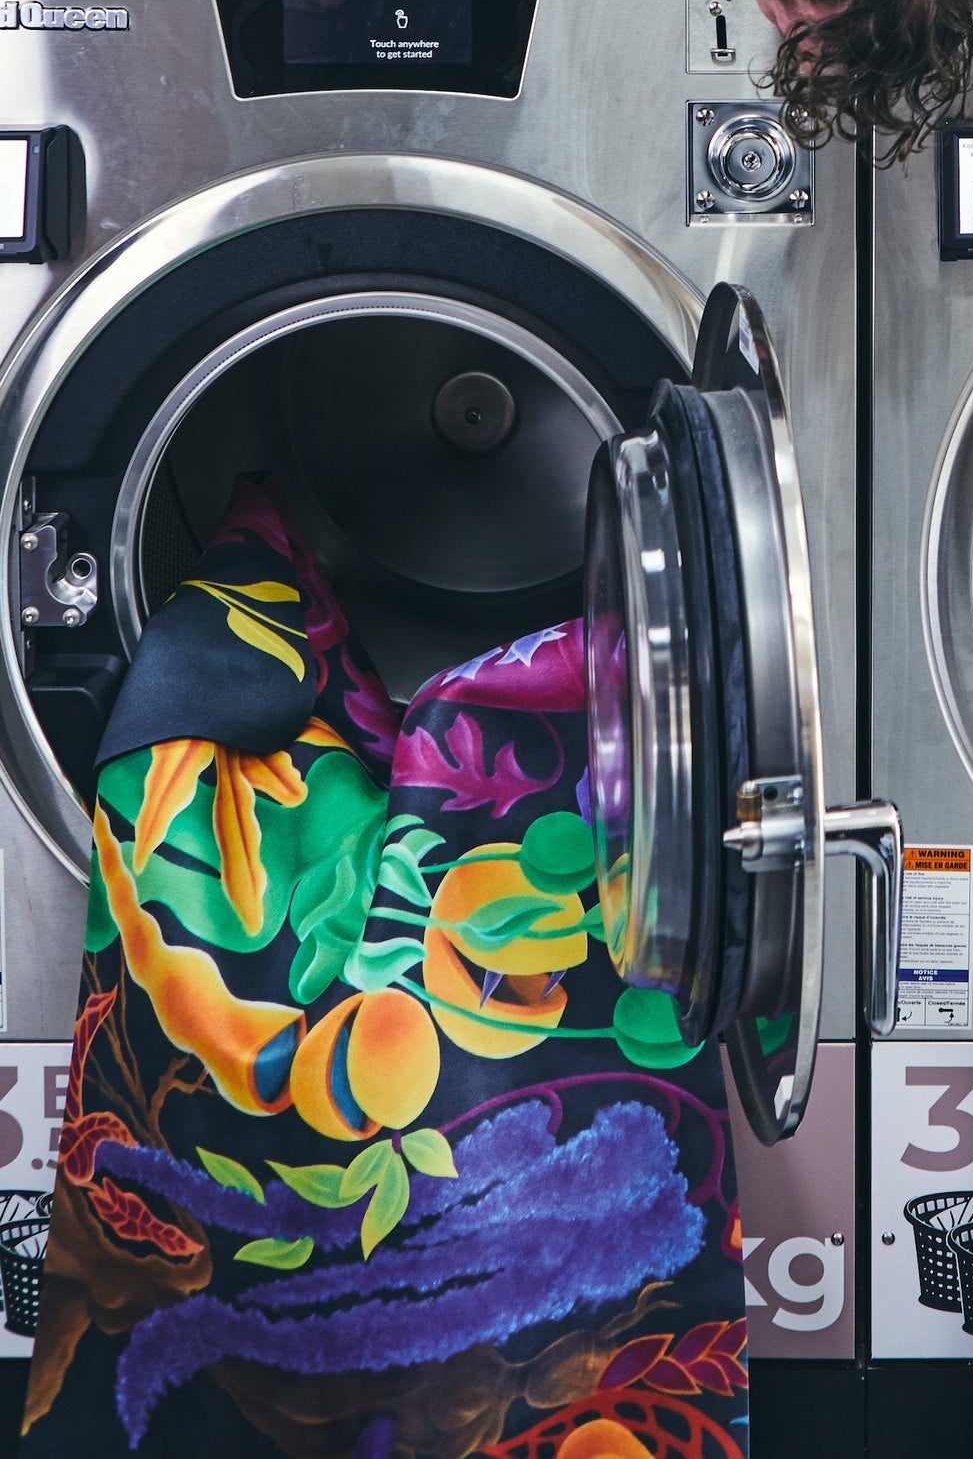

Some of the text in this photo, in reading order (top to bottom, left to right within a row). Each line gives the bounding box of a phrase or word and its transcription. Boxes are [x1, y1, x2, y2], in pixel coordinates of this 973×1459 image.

[20, 1, 130, 31] Queen
[369, 40, 439, 49] Touch anywhere
[387, 51, 401, 60] get
[918, 850, 965, 859] WARNING
[915, 861, 967, 870] MISE EN GARDE
